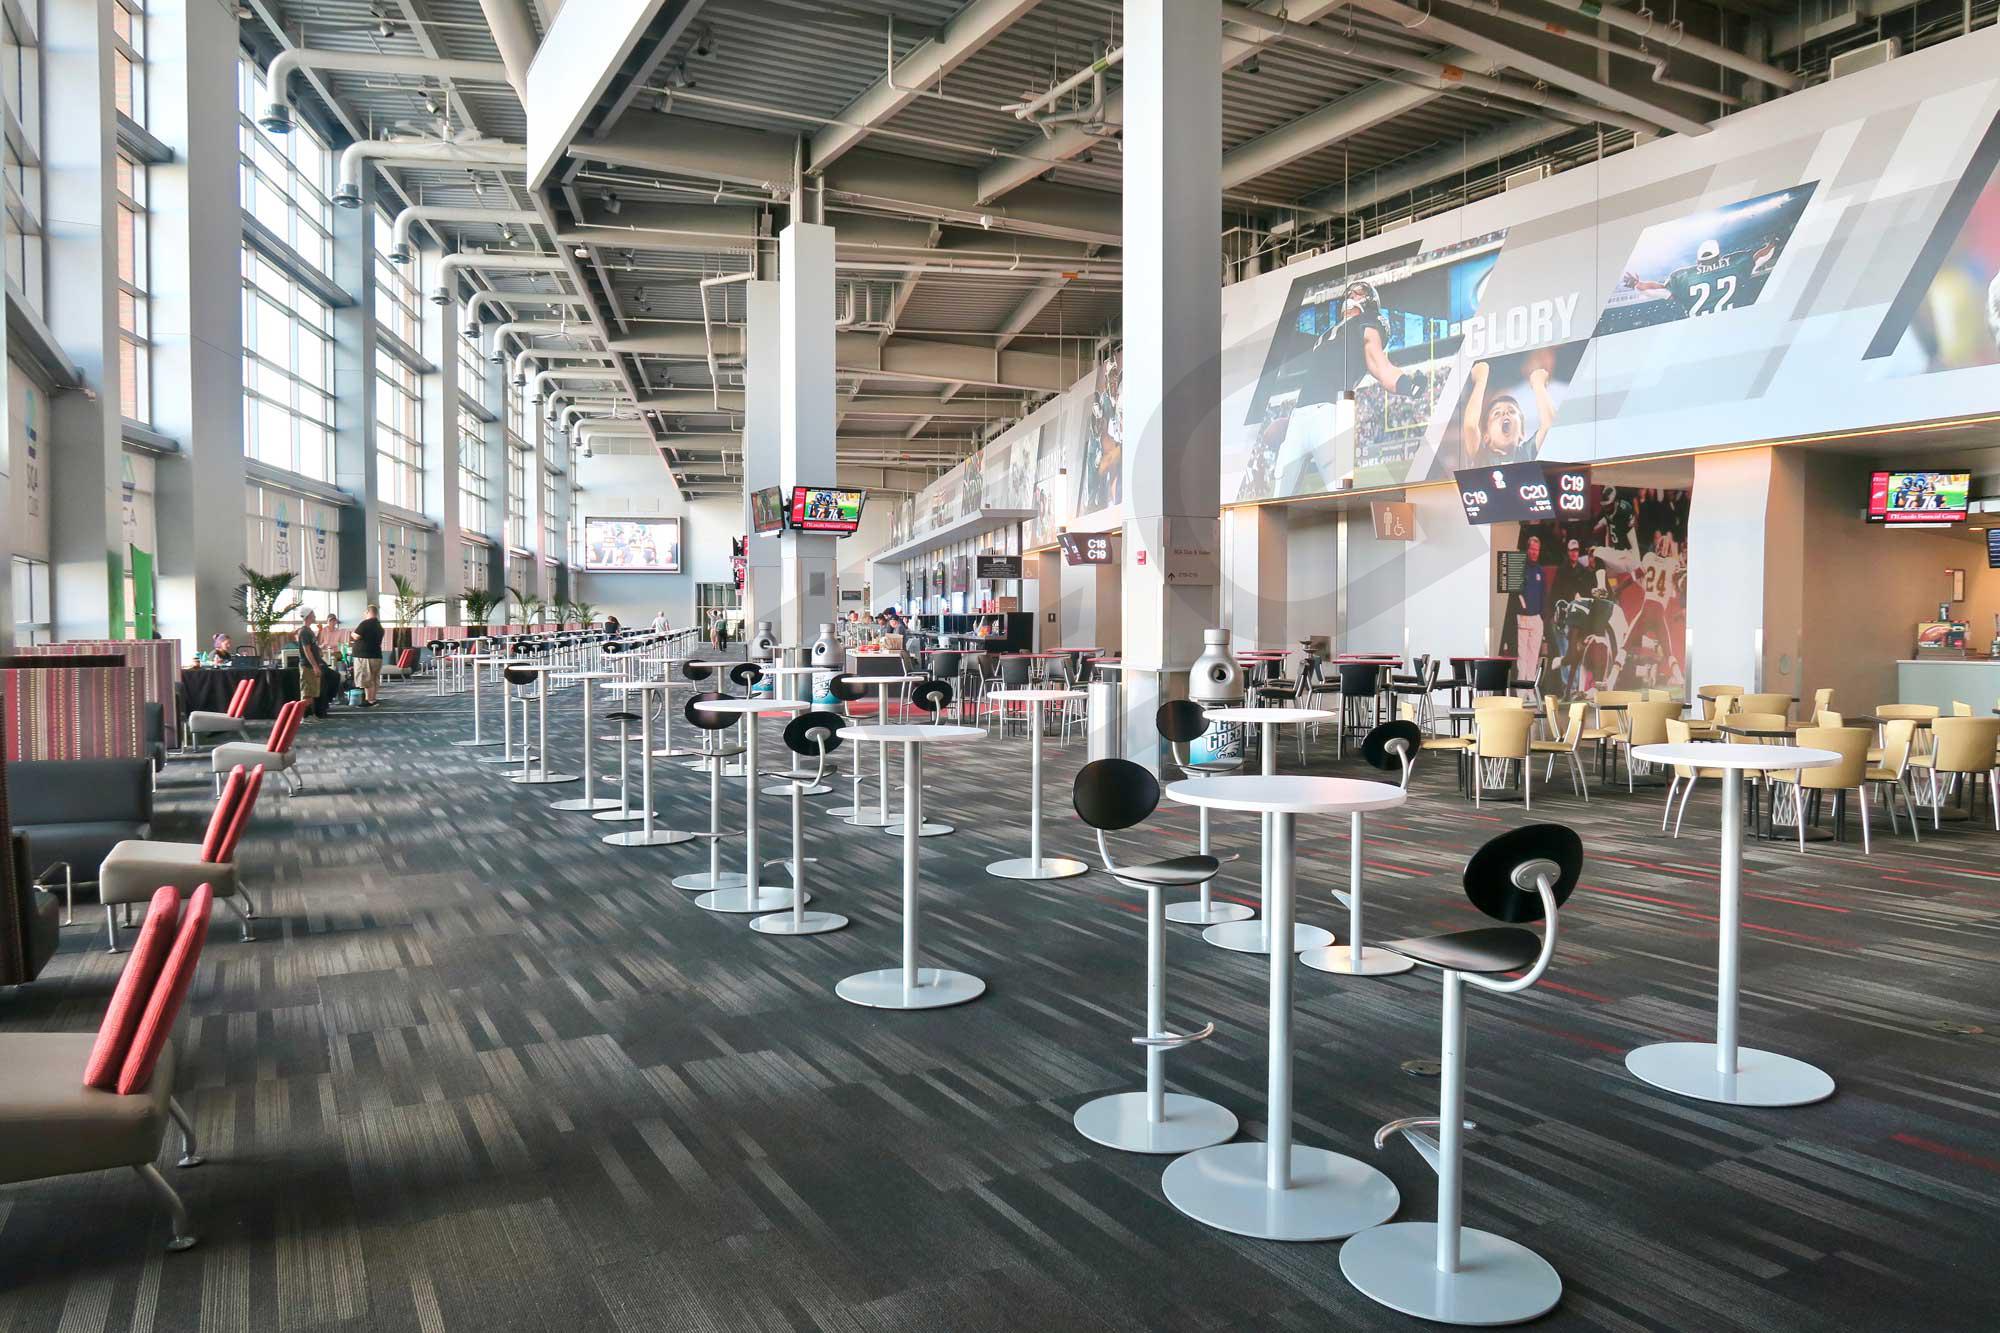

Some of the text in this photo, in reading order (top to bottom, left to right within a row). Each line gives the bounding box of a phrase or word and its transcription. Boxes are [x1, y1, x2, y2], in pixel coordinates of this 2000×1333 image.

[1688, 275, 1736, 317] 22
[1462, 292, 1579, 357] GLORY
[1563, 474, 1584, 491] C19
[1462, 490, 1488, 506] C19
[1519, 484, 1548, 500] C20
[1561, 493, 1584, 510] C20
[1921, 496, 1937, 508] 76
[1087, 538, 1106, 549] C18
[1646, 566, 1669, 598] 24
